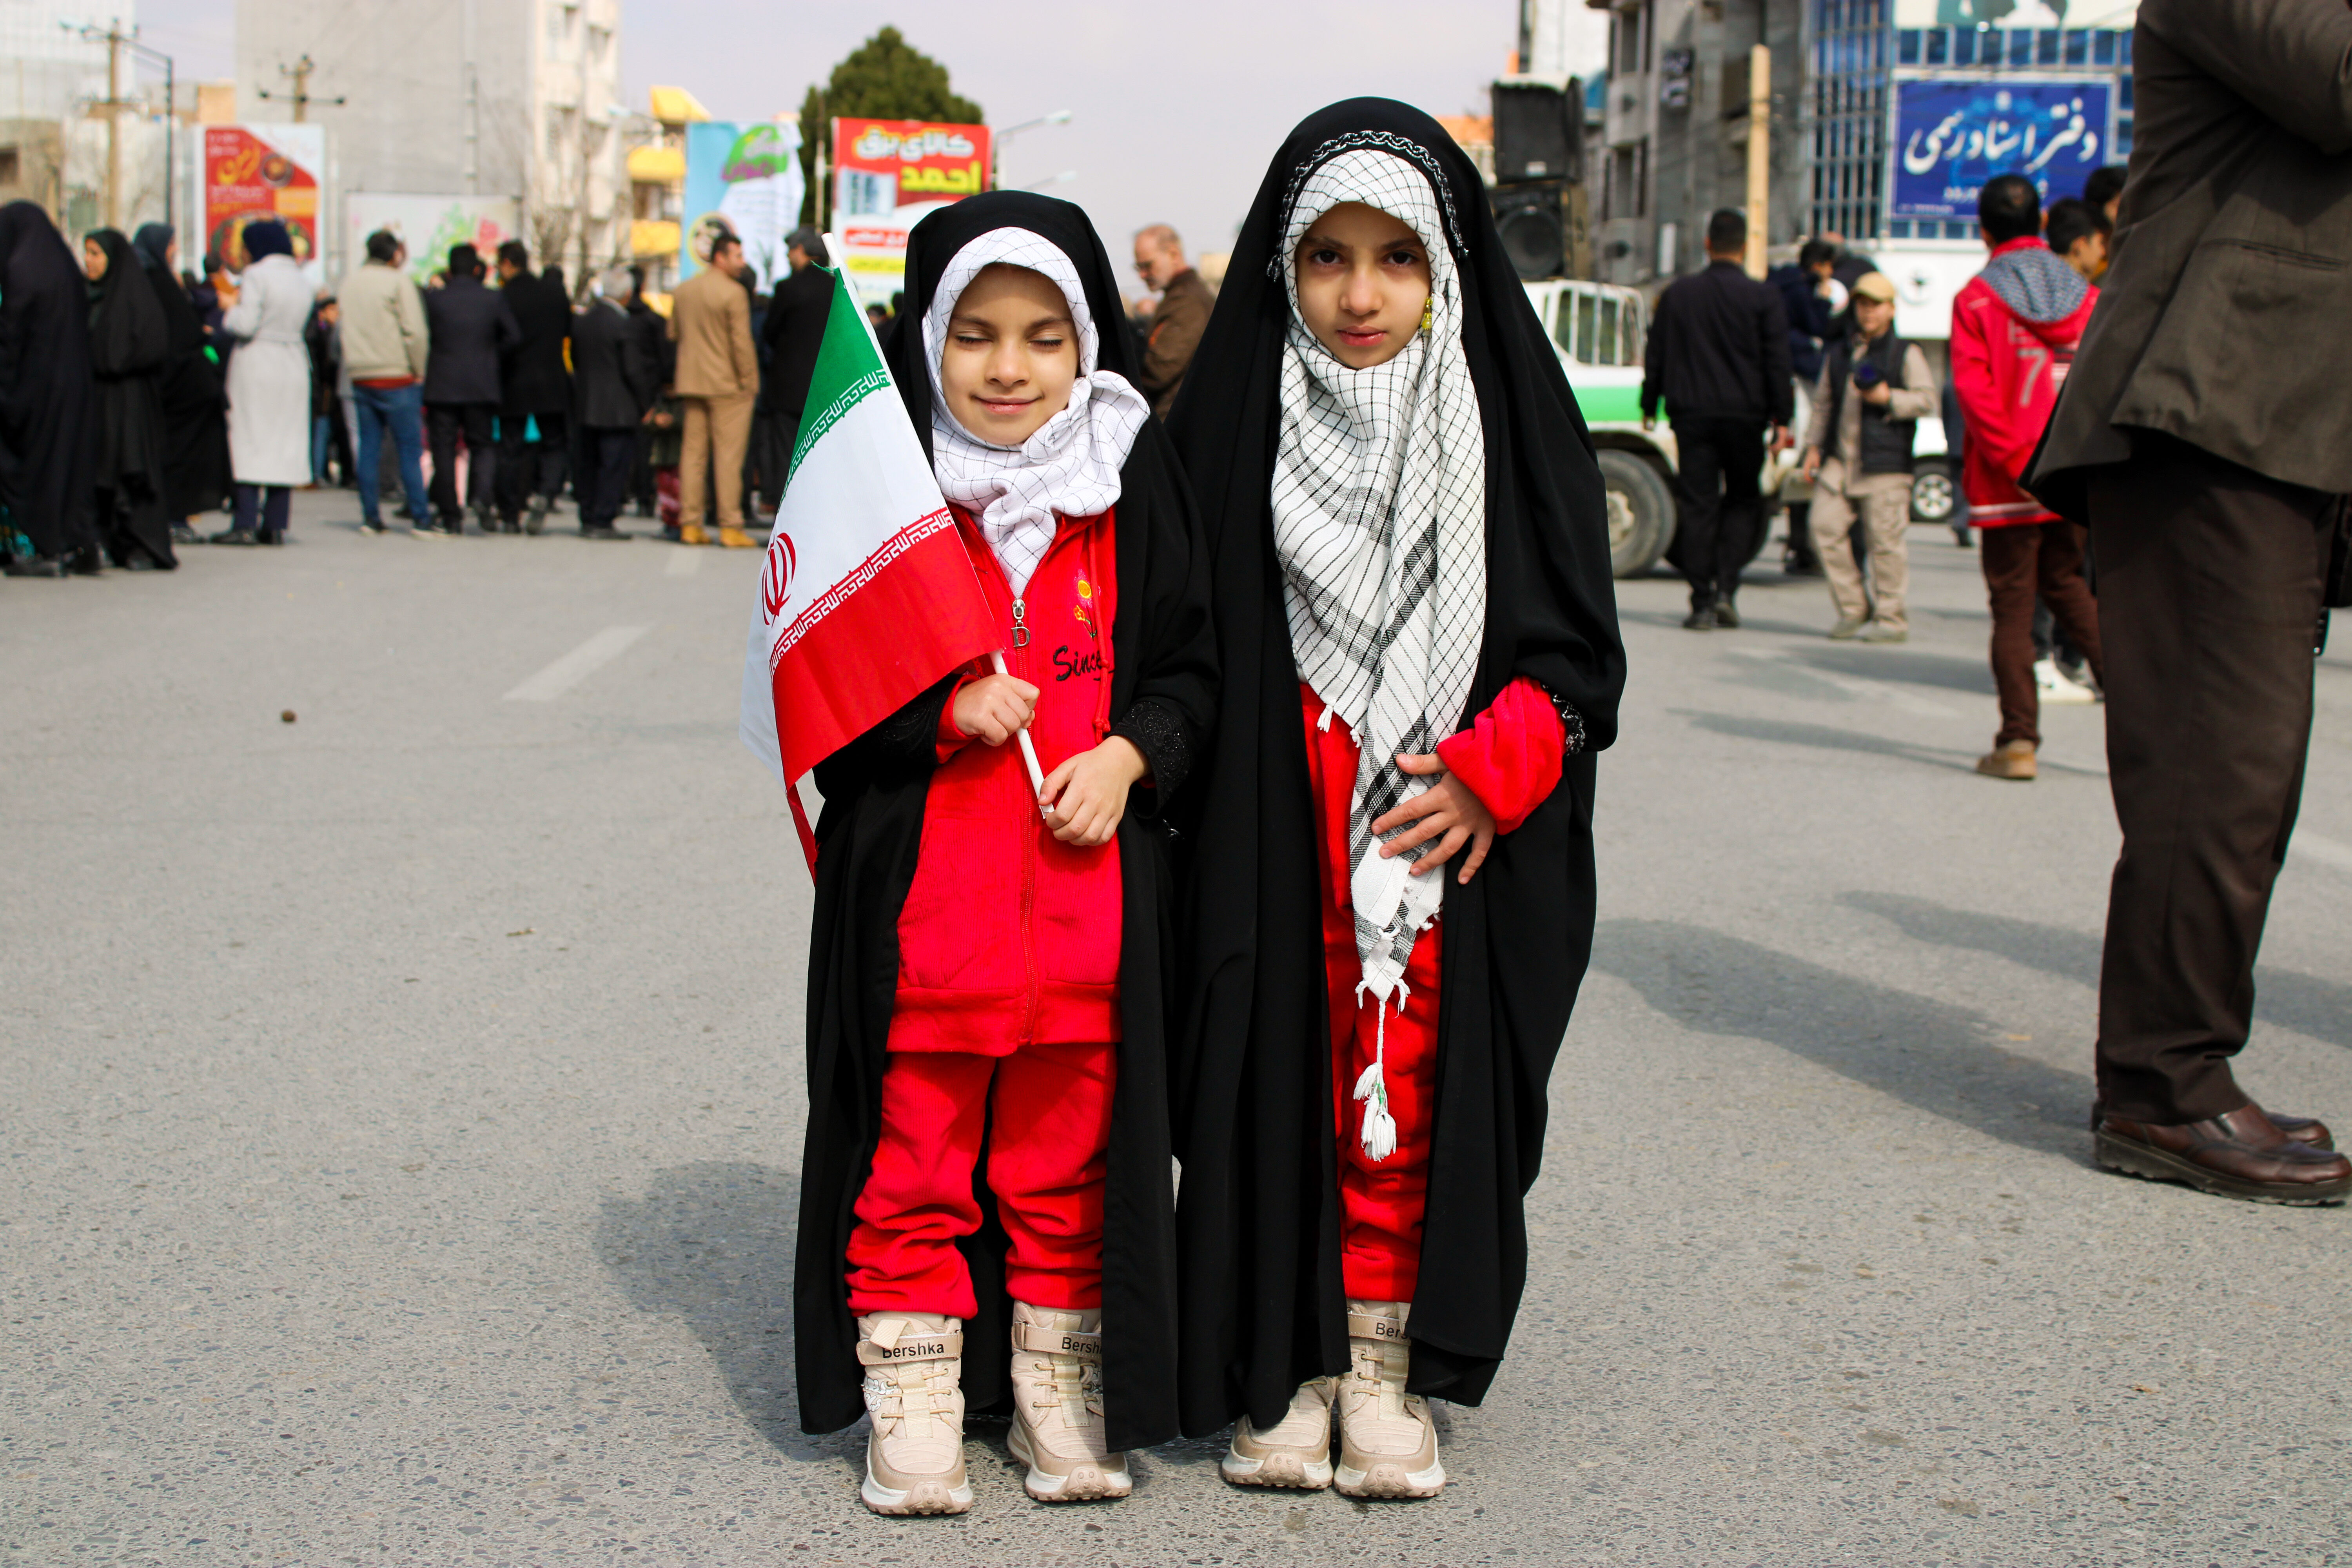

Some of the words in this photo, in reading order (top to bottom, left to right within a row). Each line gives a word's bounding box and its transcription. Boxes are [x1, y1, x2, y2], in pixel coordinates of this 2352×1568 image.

[855, 127, 900, 160] برق
[899, 131, 975, 163] کالای
[1904, 110, 1966, 175] رسمی
[1965, 118, 2036, 161] اسناد
[2023, 96, 2098, 175] دفتر
[900, 160, 982, 195] احمد
[2017, 347, 2048, 408] 7
[1011, 626, 1031, 648] D
[1053, 645, 1102, 681] Since
[882, 1342, 944, 1358] Bershka
